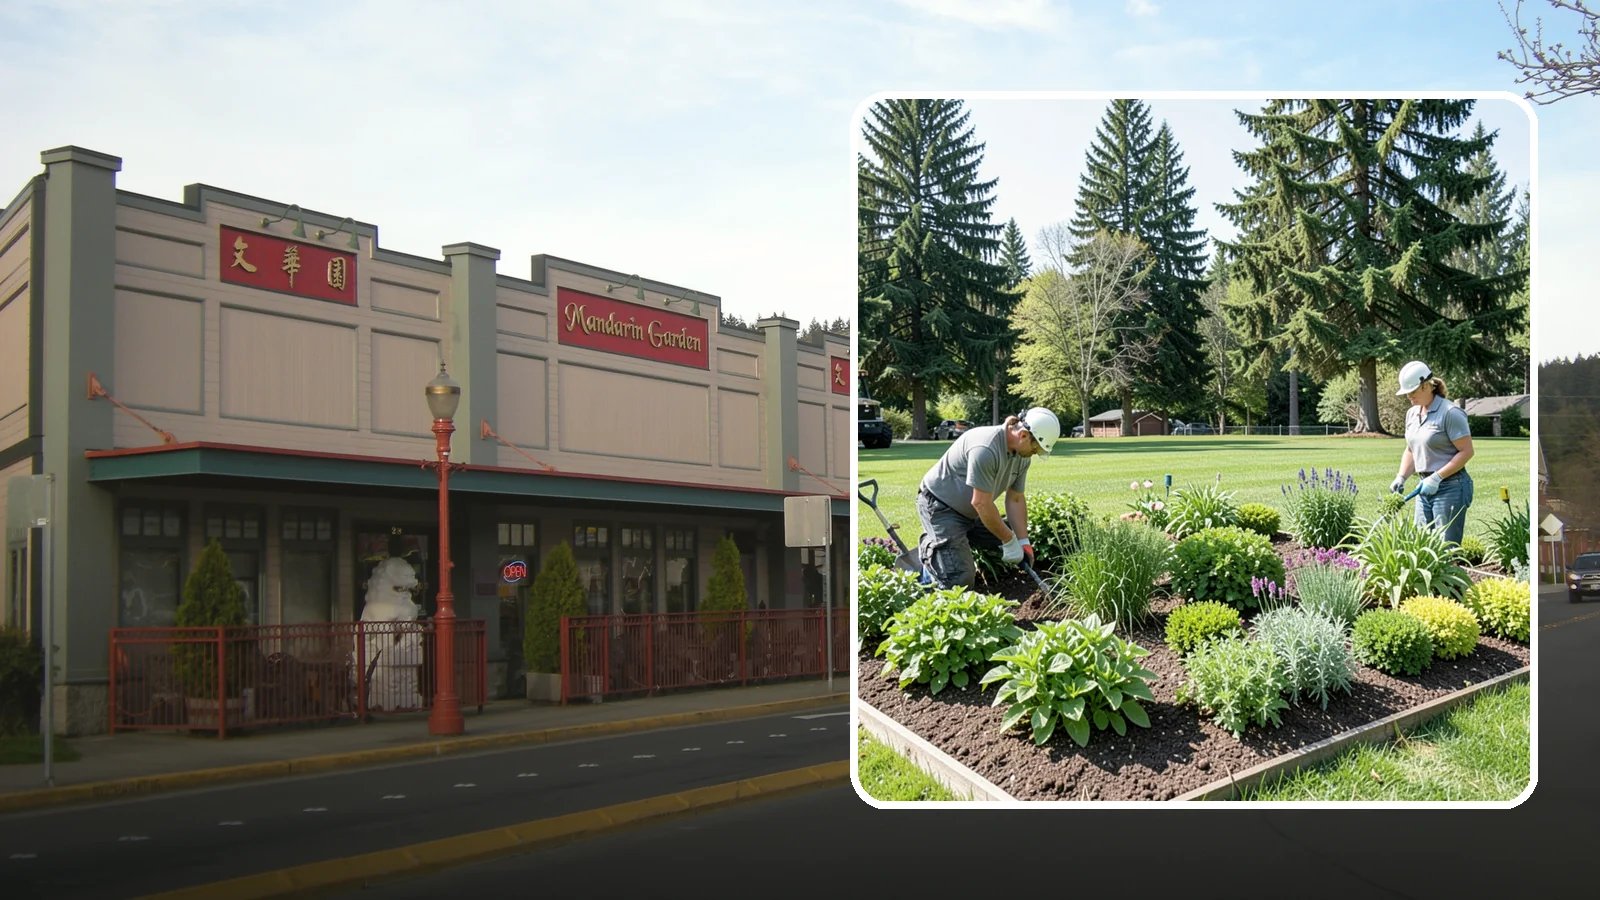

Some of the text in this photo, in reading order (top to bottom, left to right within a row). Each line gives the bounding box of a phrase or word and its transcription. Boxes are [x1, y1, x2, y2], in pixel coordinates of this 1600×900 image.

[231, 236, 346, 291] 文華園
[564, 302, 702, 352] Mandarin Garden
[834, 363, 846, 386] 文
[503, 565, 527, 578] OPEN
